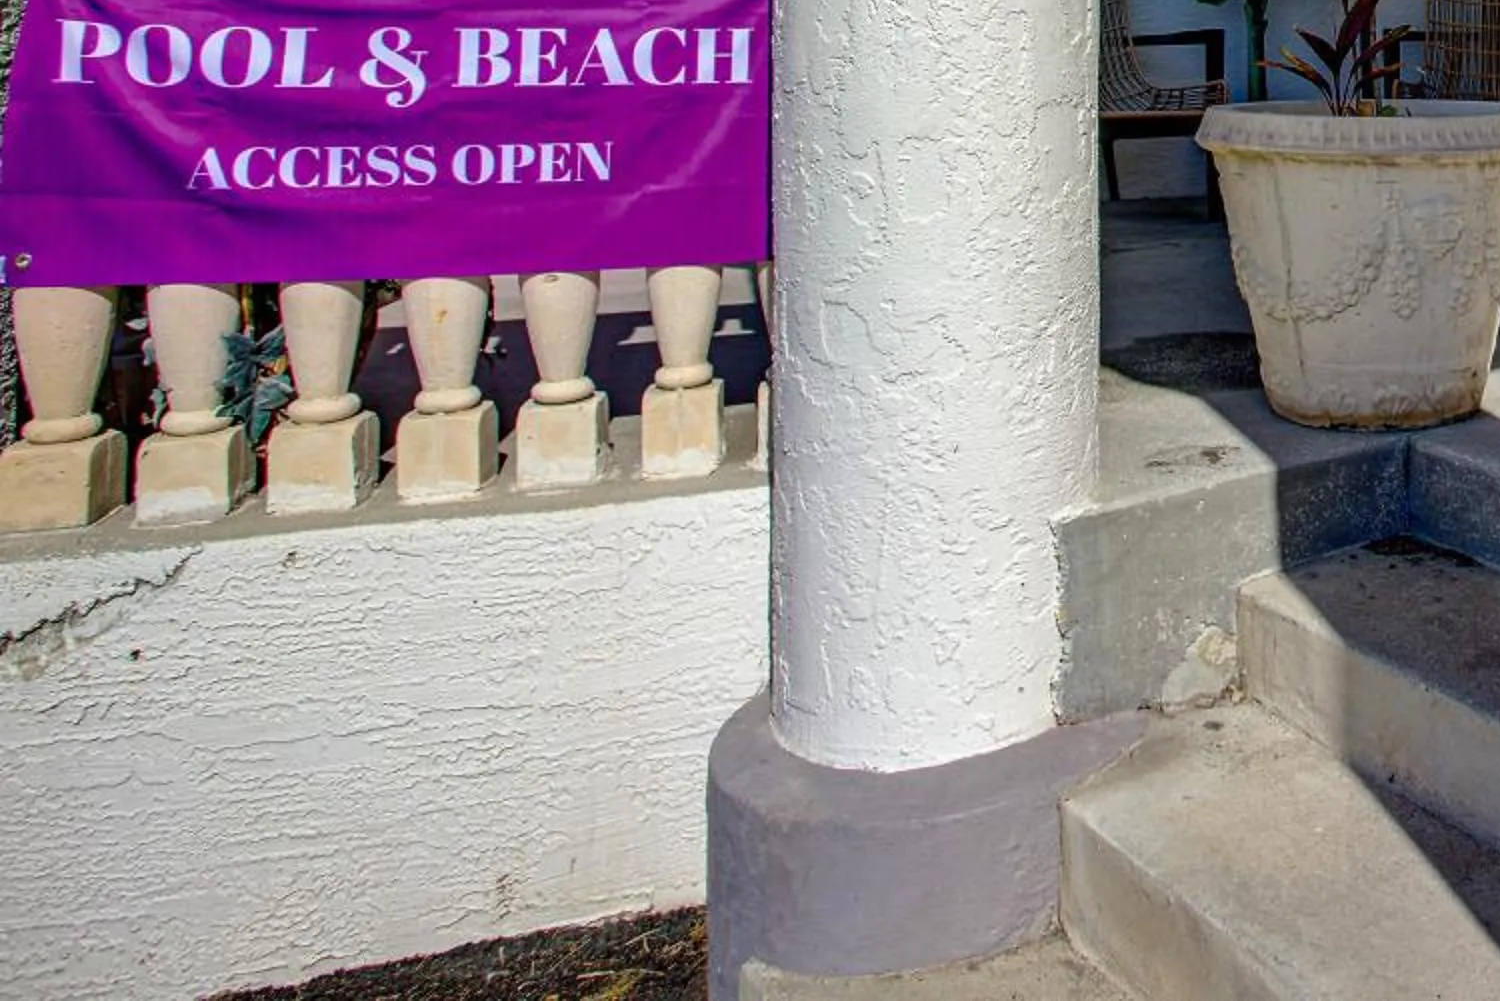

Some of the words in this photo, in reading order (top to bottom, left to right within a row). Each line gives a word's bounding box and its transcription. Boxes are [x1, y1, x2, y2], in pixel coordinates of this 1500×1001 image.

[52, 18, 335, 89] POOL
[359, 26, 430, 108] &
[451, 25, 755, 89] BEACH
[187, 144, 437, 192] ACCESS
[453, 141, 615, 186] OPEN
